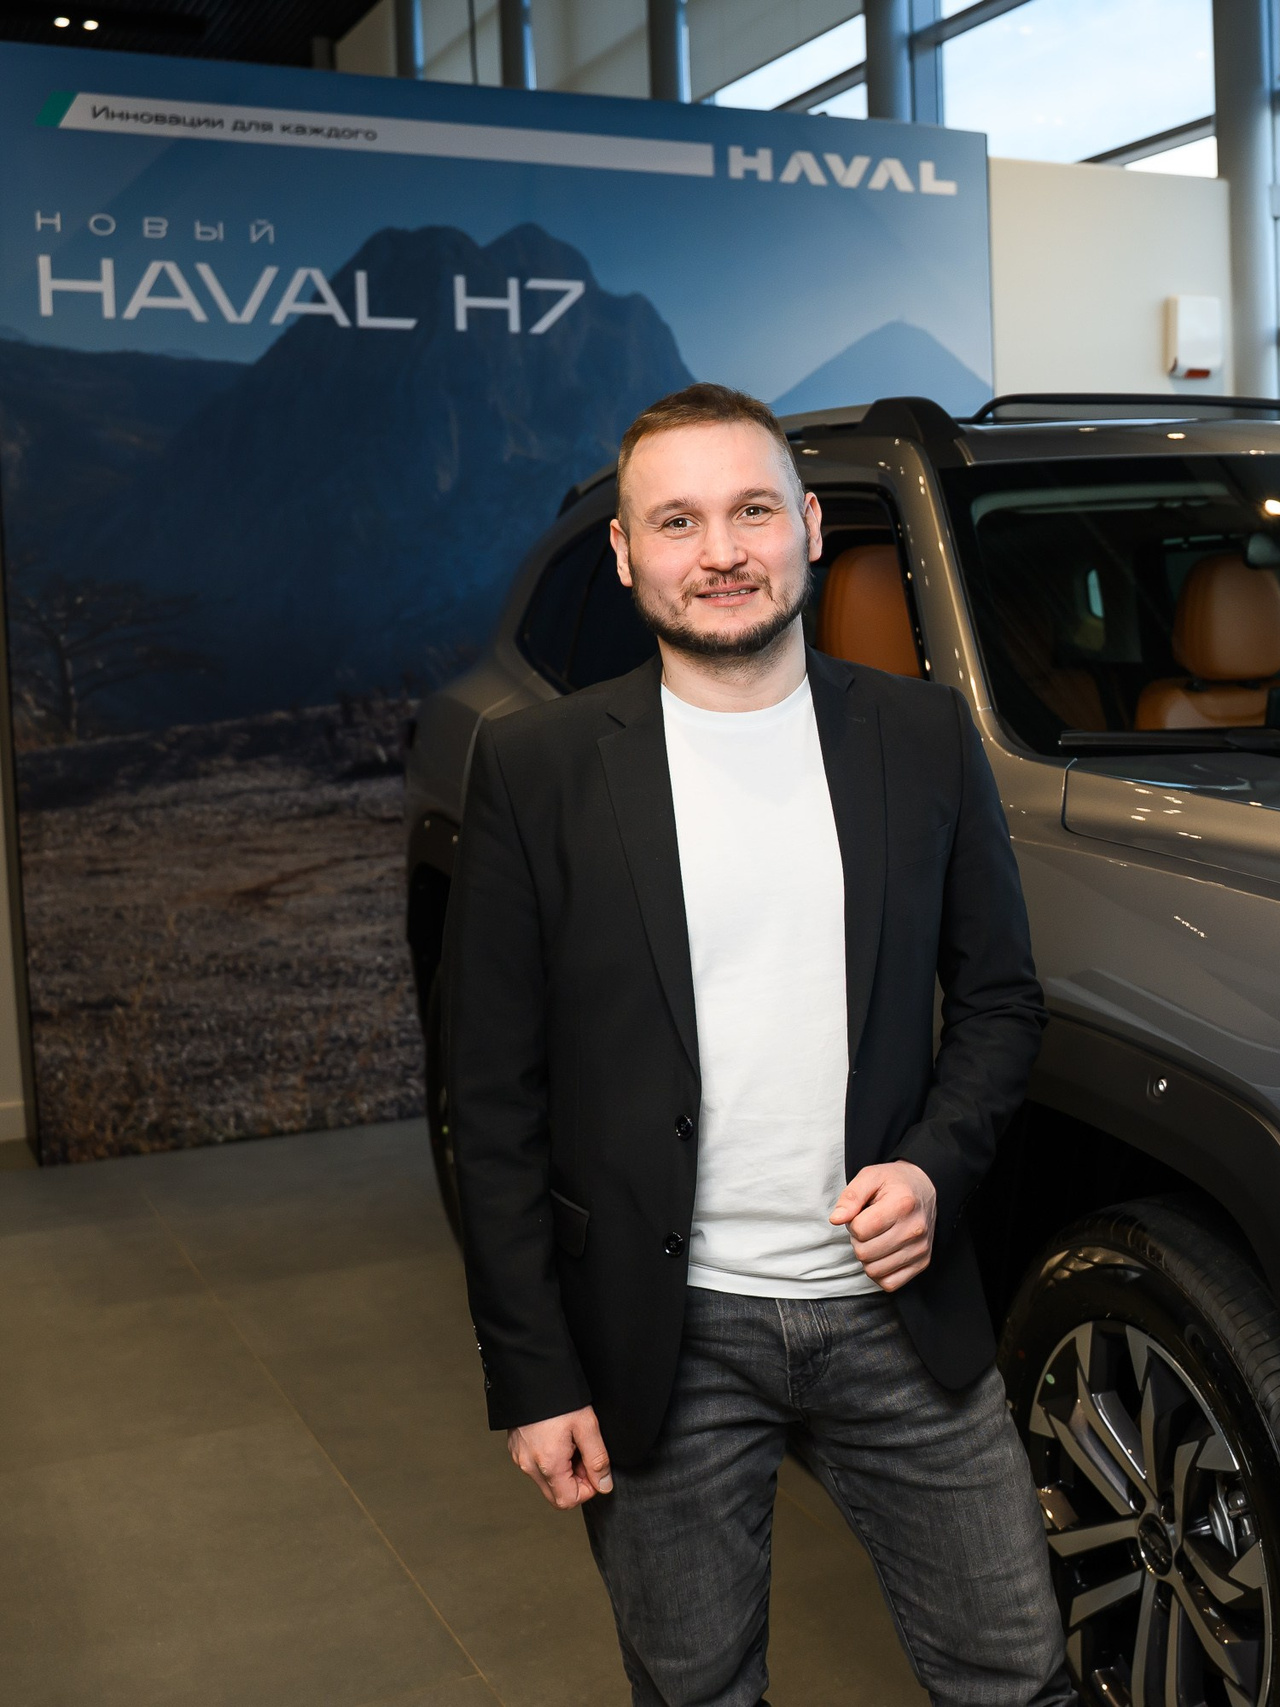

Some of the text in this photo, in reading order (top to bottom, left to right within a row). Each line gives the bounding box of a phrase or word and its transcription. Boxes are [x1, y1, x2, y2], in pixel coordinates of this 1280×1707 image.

[91, 105, 378, 142] Инновации для каждого
[728, 145, 958, 195] HAVAL
[36, 209, 276, 244] НОВЫЙ
[38, 254, 587, 335] HAVAL H7
